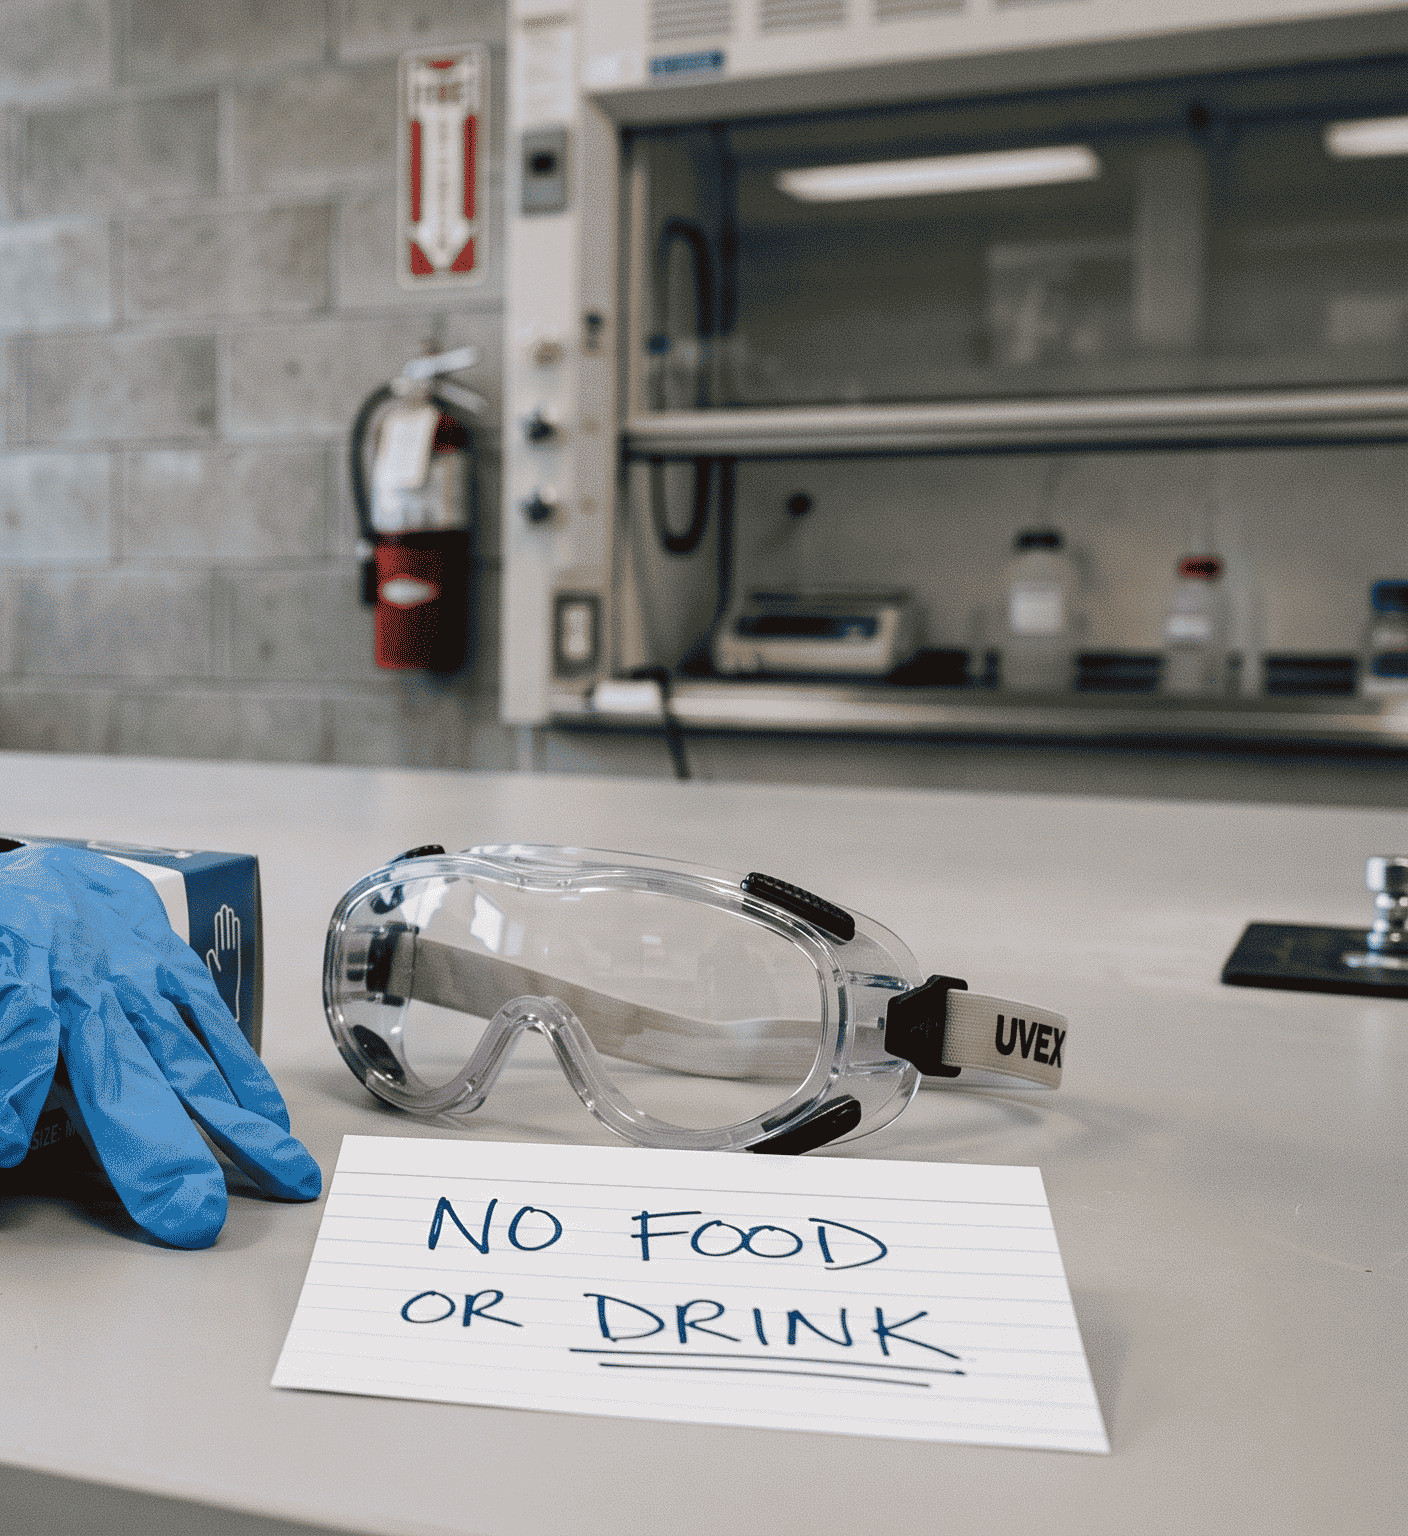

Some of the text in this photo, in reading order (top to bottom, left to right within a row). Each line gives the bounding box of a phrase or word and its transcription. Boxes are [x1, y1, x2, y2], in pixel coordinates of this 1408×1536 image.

[995, 1014, 1066, 1068] UVEX
[428, 1197, 888, 1270] NO FOOD
[400, 1289, 960, 1360] OR DRINK
